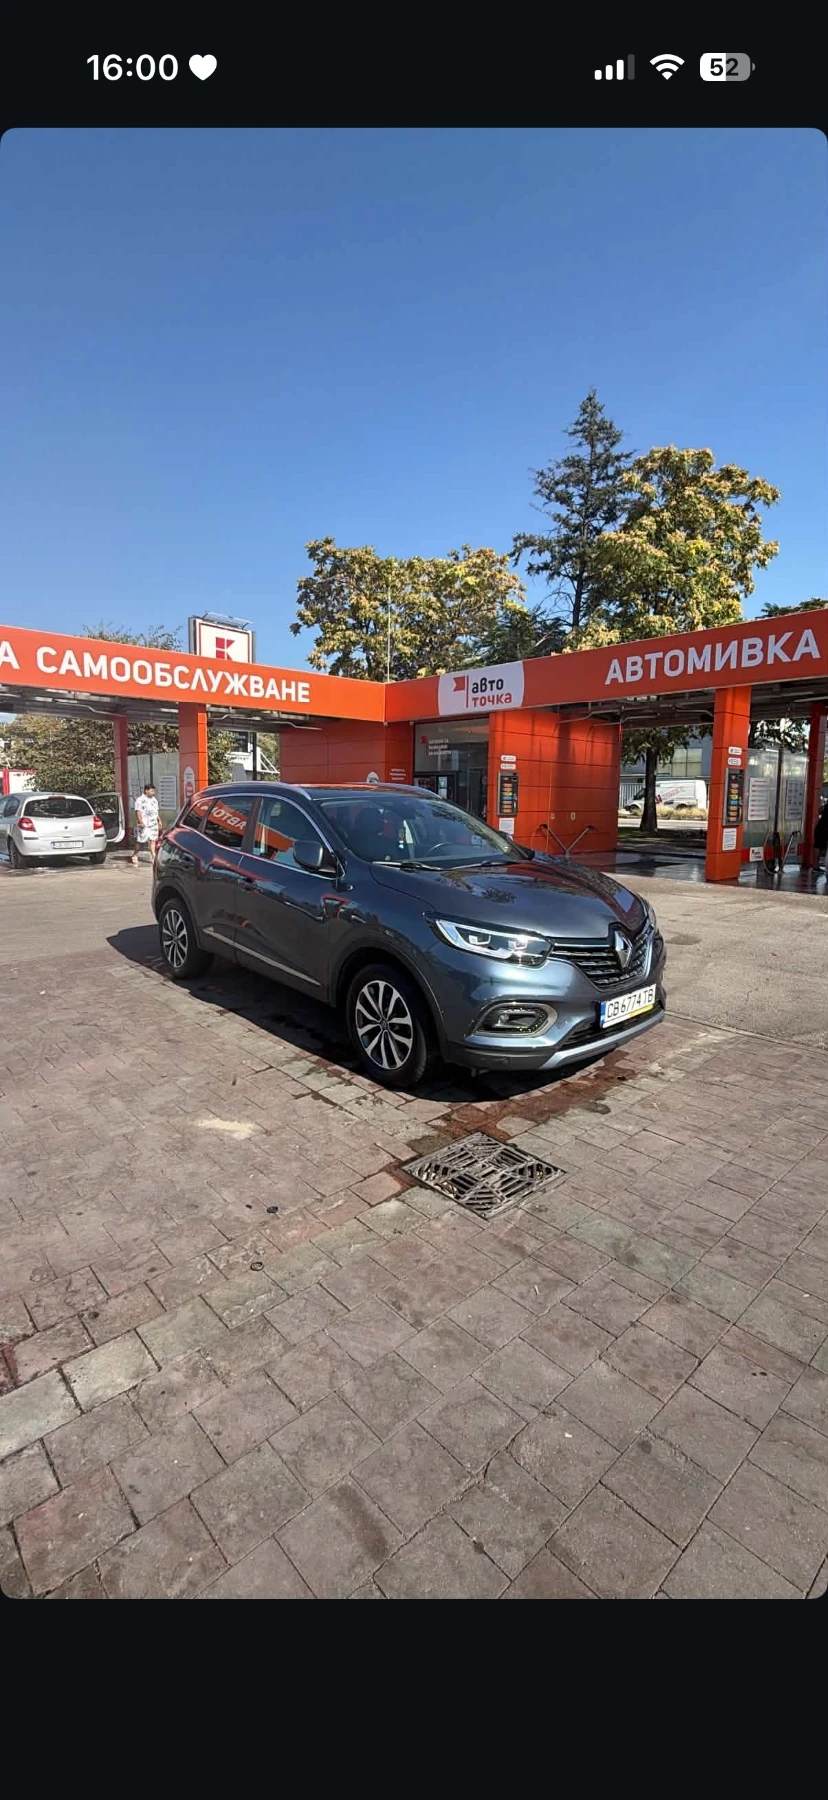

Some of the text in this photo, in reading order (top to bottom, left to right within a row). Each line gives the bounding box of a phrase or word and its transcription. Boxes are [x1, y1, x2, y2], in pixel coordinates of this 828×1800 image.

[36, 646, 311, 703] САМООБСЛУЖВАНЕ
[604, 628, 821, 685] АВТОМИВКА
[621, 992, 642, 1013] 6774
